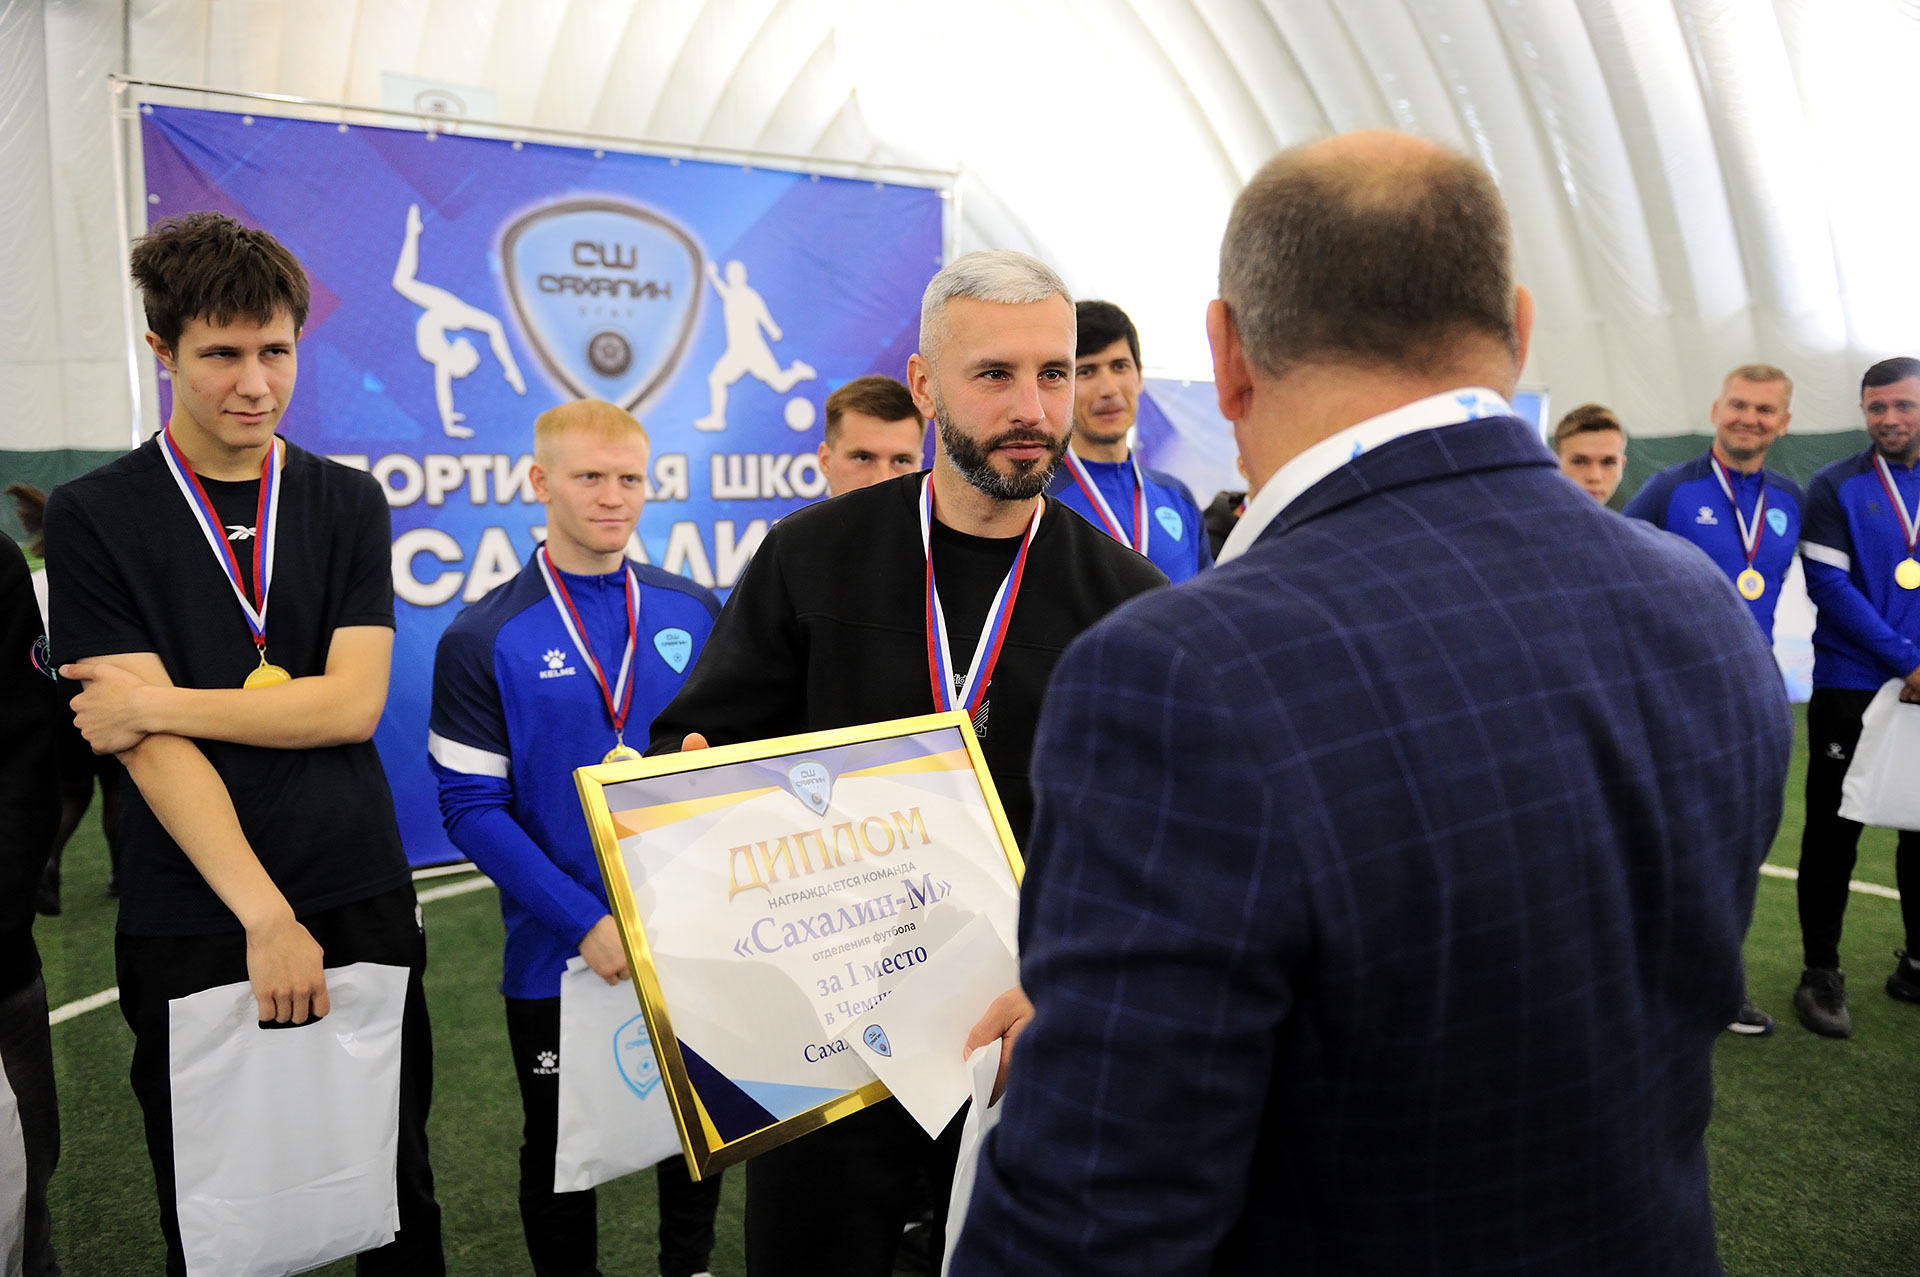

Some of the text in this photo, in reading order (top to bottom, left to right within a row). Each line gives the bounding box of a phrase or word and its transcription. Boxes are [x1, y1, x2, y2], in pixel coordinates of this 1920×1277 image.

[573, 241, 637, 270] СШ
[538, 274, 672, 300] САХАЛИН
[711, 452, 833, 501] ШКО
[391, 518, 785, 608] САЛИ
[539, 666, 577, 680] KELME
[800, 769, 816, 779] СШ
[728, 807, 933, 904] ДИПЛОМ
[768, 861, 917, 909] НАГРАЖДАЕТСЯ КОМАНДА
[733, 872, 953, 959] «Сахалин-М»
[812, 922, 917, 961] отделения футбола
[816, 974, 844, 998] за
[862, 946, 929, 982] место
[824, 1012, 836, 1026] в
[803, 1039, 849, 1063] Саха
